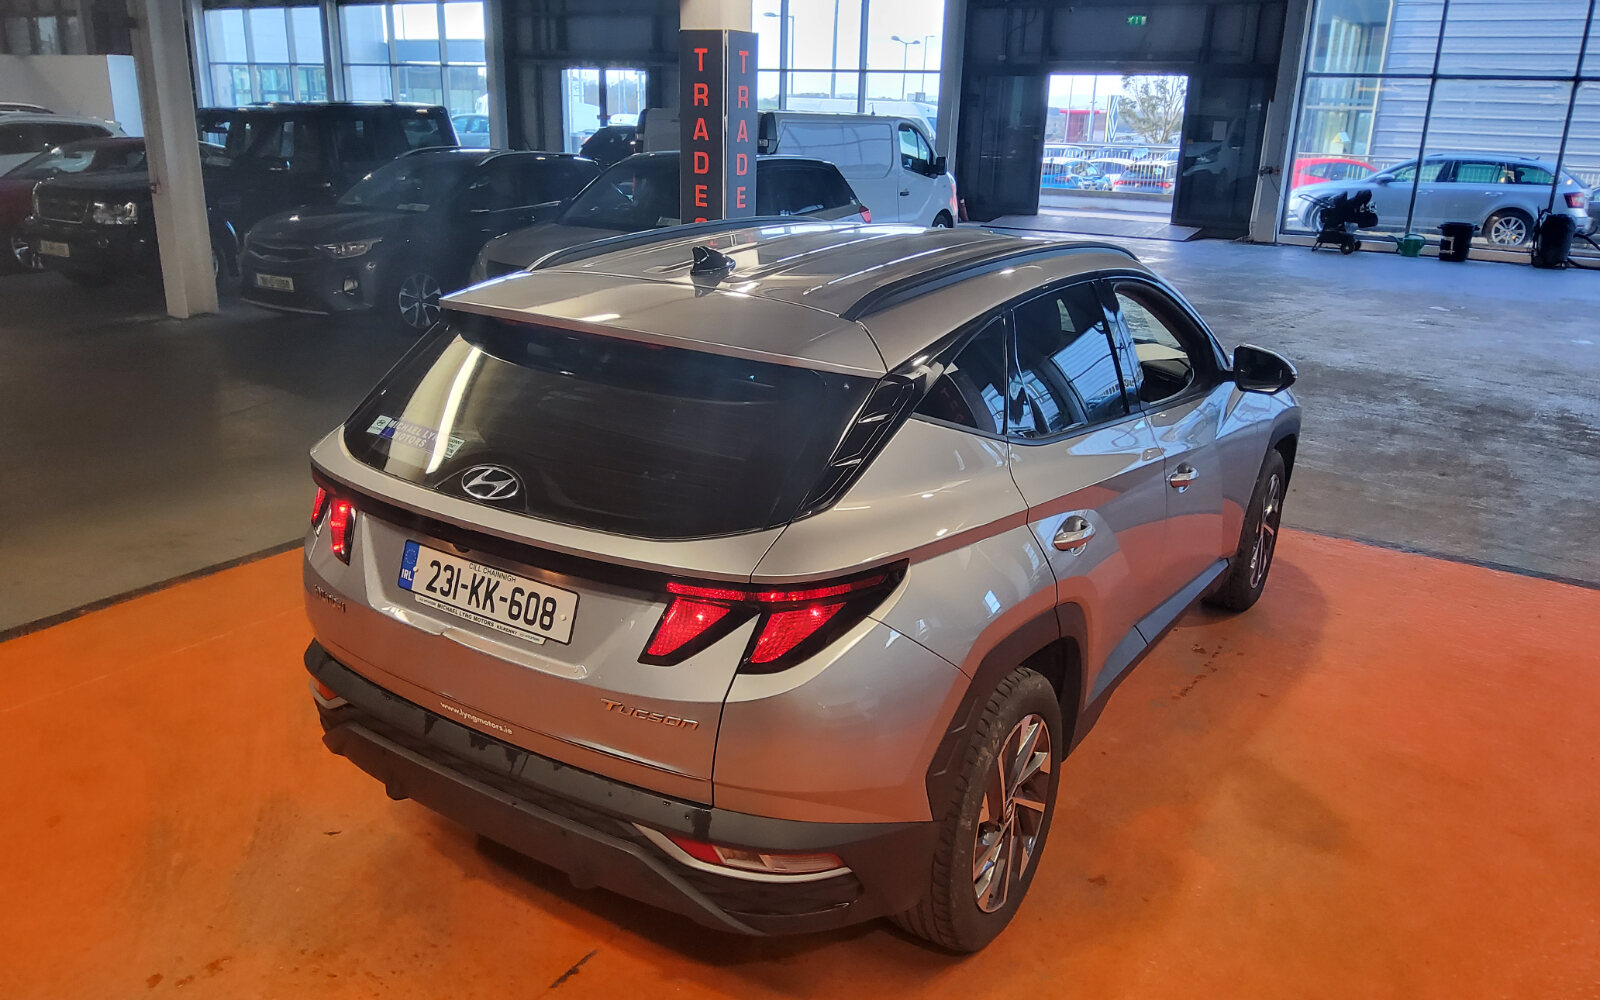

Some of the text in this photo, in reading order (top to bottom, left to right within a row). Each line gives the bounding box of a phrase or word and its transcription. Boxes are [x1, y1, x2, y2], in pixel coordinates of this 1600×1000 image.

[693, 48, 709, 223] TRADE
[736, 50, 749, 208] TRADE
[401, 568, 413, 581] IRL
[469, 562, 517, 583] CILL CHAINNIGH
[426, 560, 556, 631] 231-KK-608
[437, 603, 458, 615] MICHAEL
[473, 616, 495, 627] MOTORS
[440, 702, 513, 735] www.lyngmotors.ie
